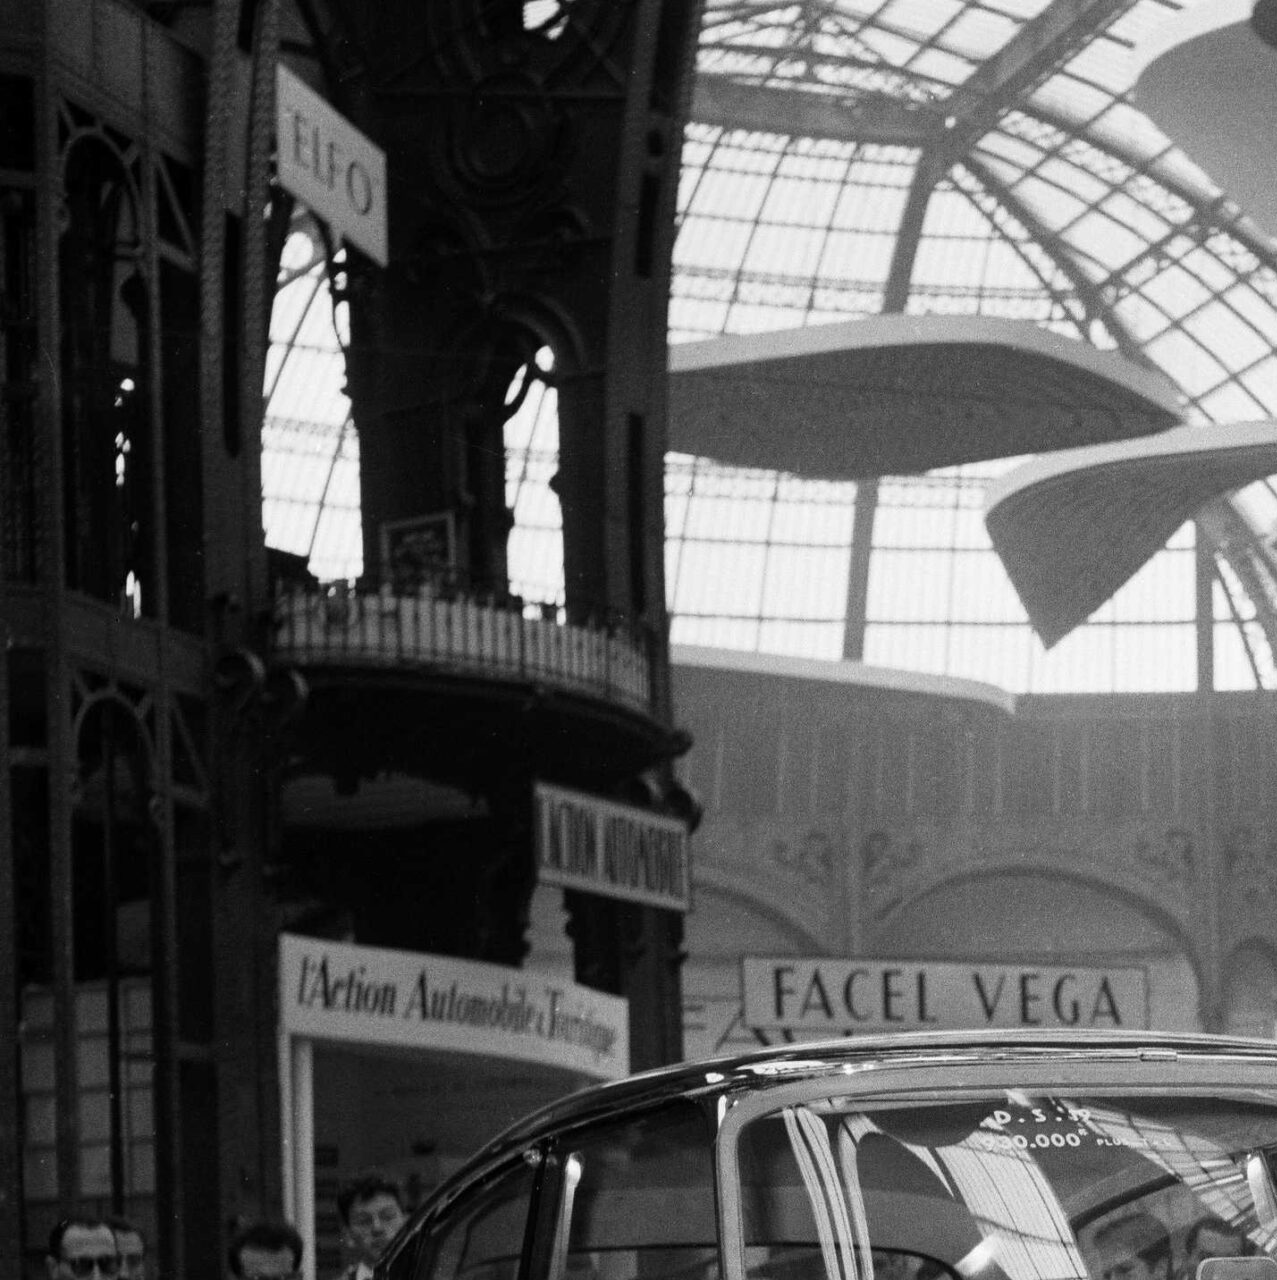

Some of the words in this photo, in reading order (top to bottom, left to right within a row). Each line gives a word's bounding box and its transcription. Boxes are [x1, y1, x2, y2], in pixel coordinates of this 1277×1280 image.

[299, 954, 397, 1015] l'Action
[403, 968, 534, 1034] Automobile
[773, 967, 938, 1023] FACEL
[973, 972, 1123, 1027] VEGA
